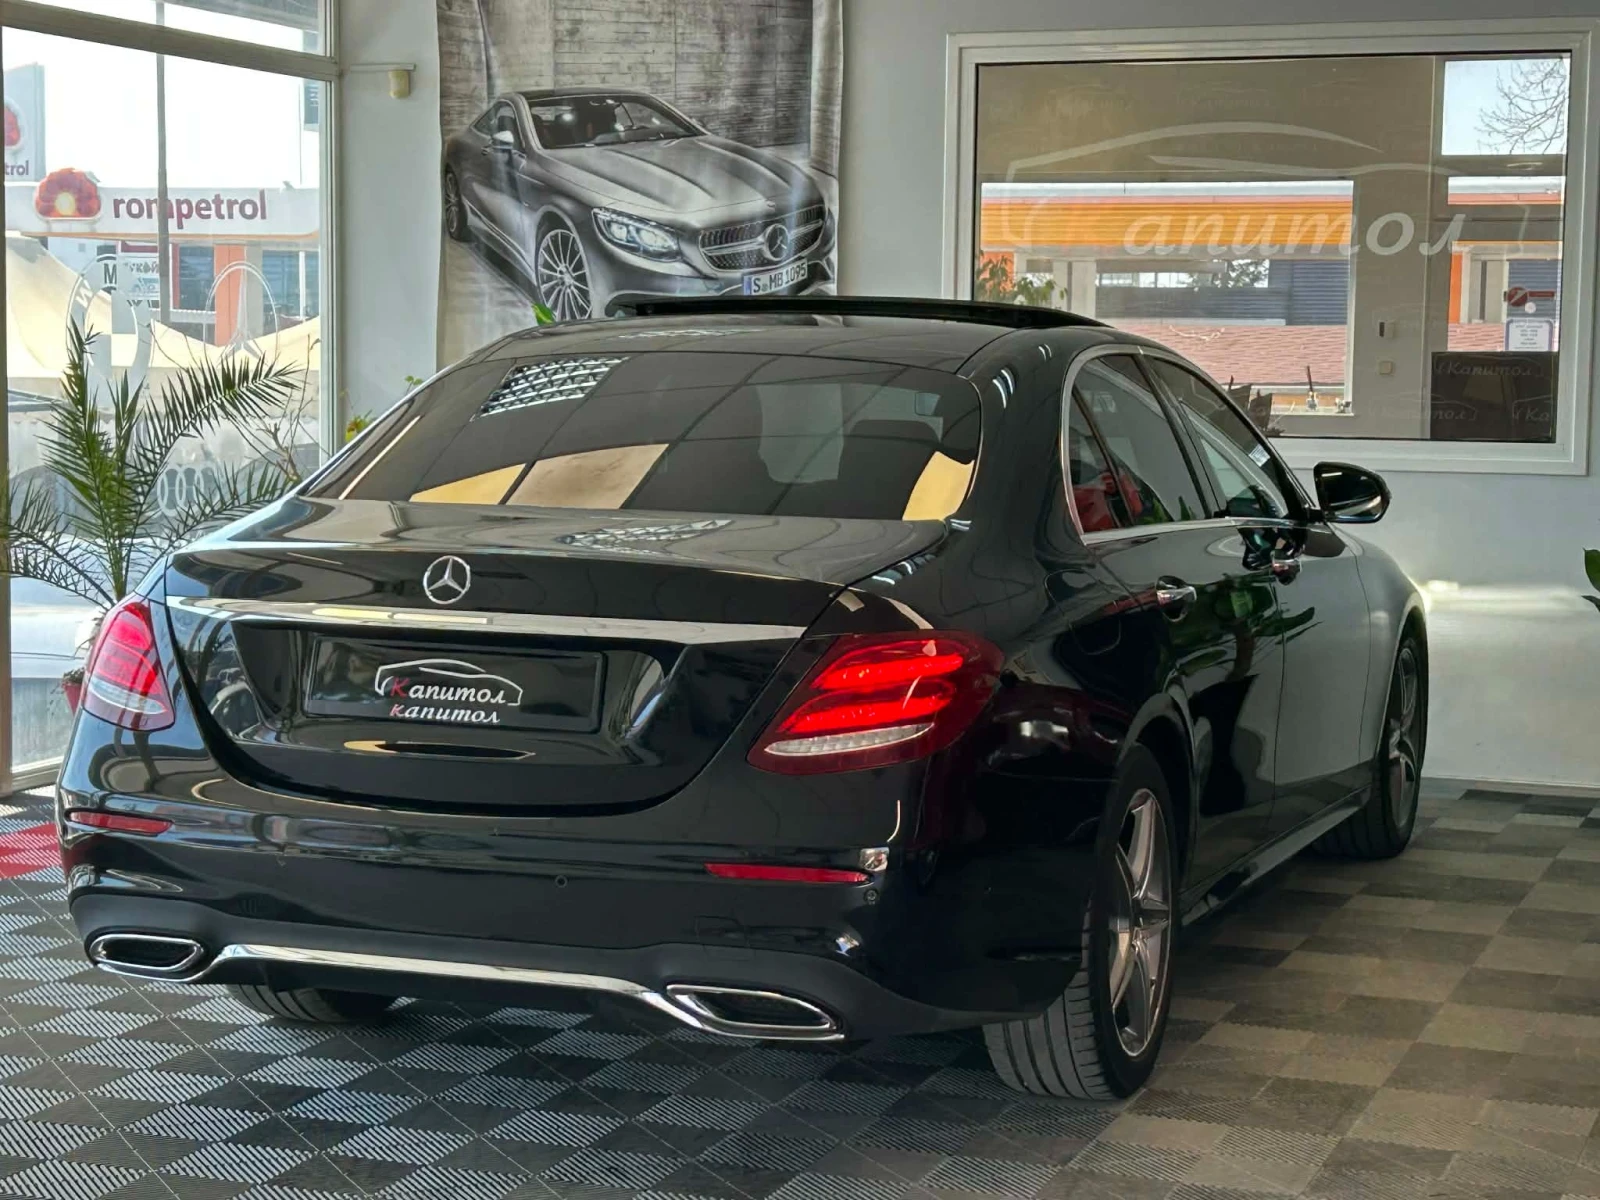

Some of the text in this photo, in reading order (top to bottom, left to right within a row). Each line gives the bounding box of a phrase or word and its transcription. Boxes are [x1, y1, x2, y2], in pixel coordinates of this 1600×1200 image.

[113, 189, 267, 230] rompetrol
[1062, 205, 1474, 256] апитол
[753, 278, 761, 293] S
[391, 677, 506, 704] Капитол
